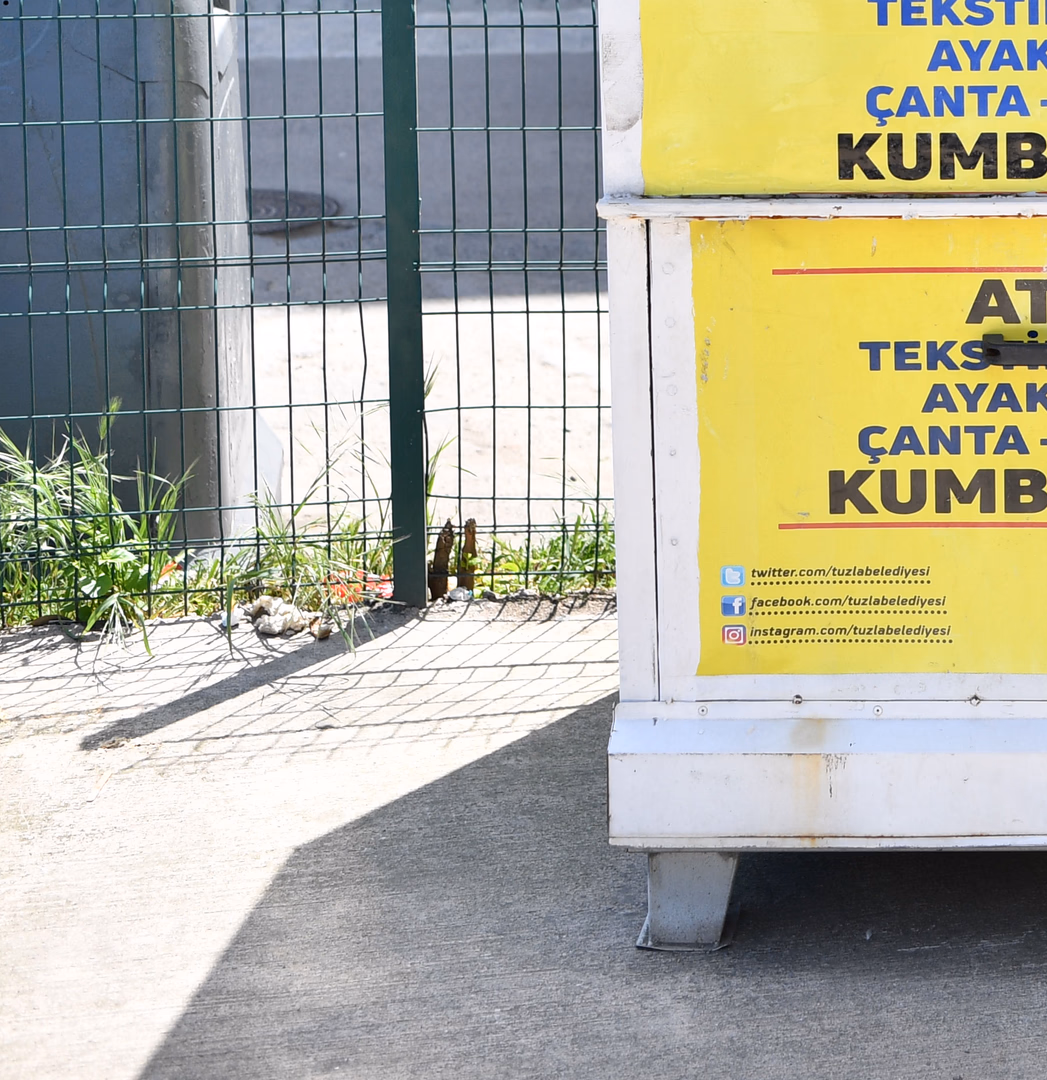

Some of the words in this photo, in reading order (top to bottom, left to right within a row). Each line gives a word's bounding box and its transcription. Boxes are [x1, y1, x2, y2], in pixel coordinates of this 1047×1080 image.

[865, 85, 1031, 127] ÇANTA
[858, 425, 1030, 464] ÇANTA
[751, 566, 930, 579] twitter.com/tuzlabelediyesi
[749, 595, 946, 610] facebook.com/tuzlabelediyesi
[750, 624, 951, 639] instagram.com/tuzlabelediyesi
